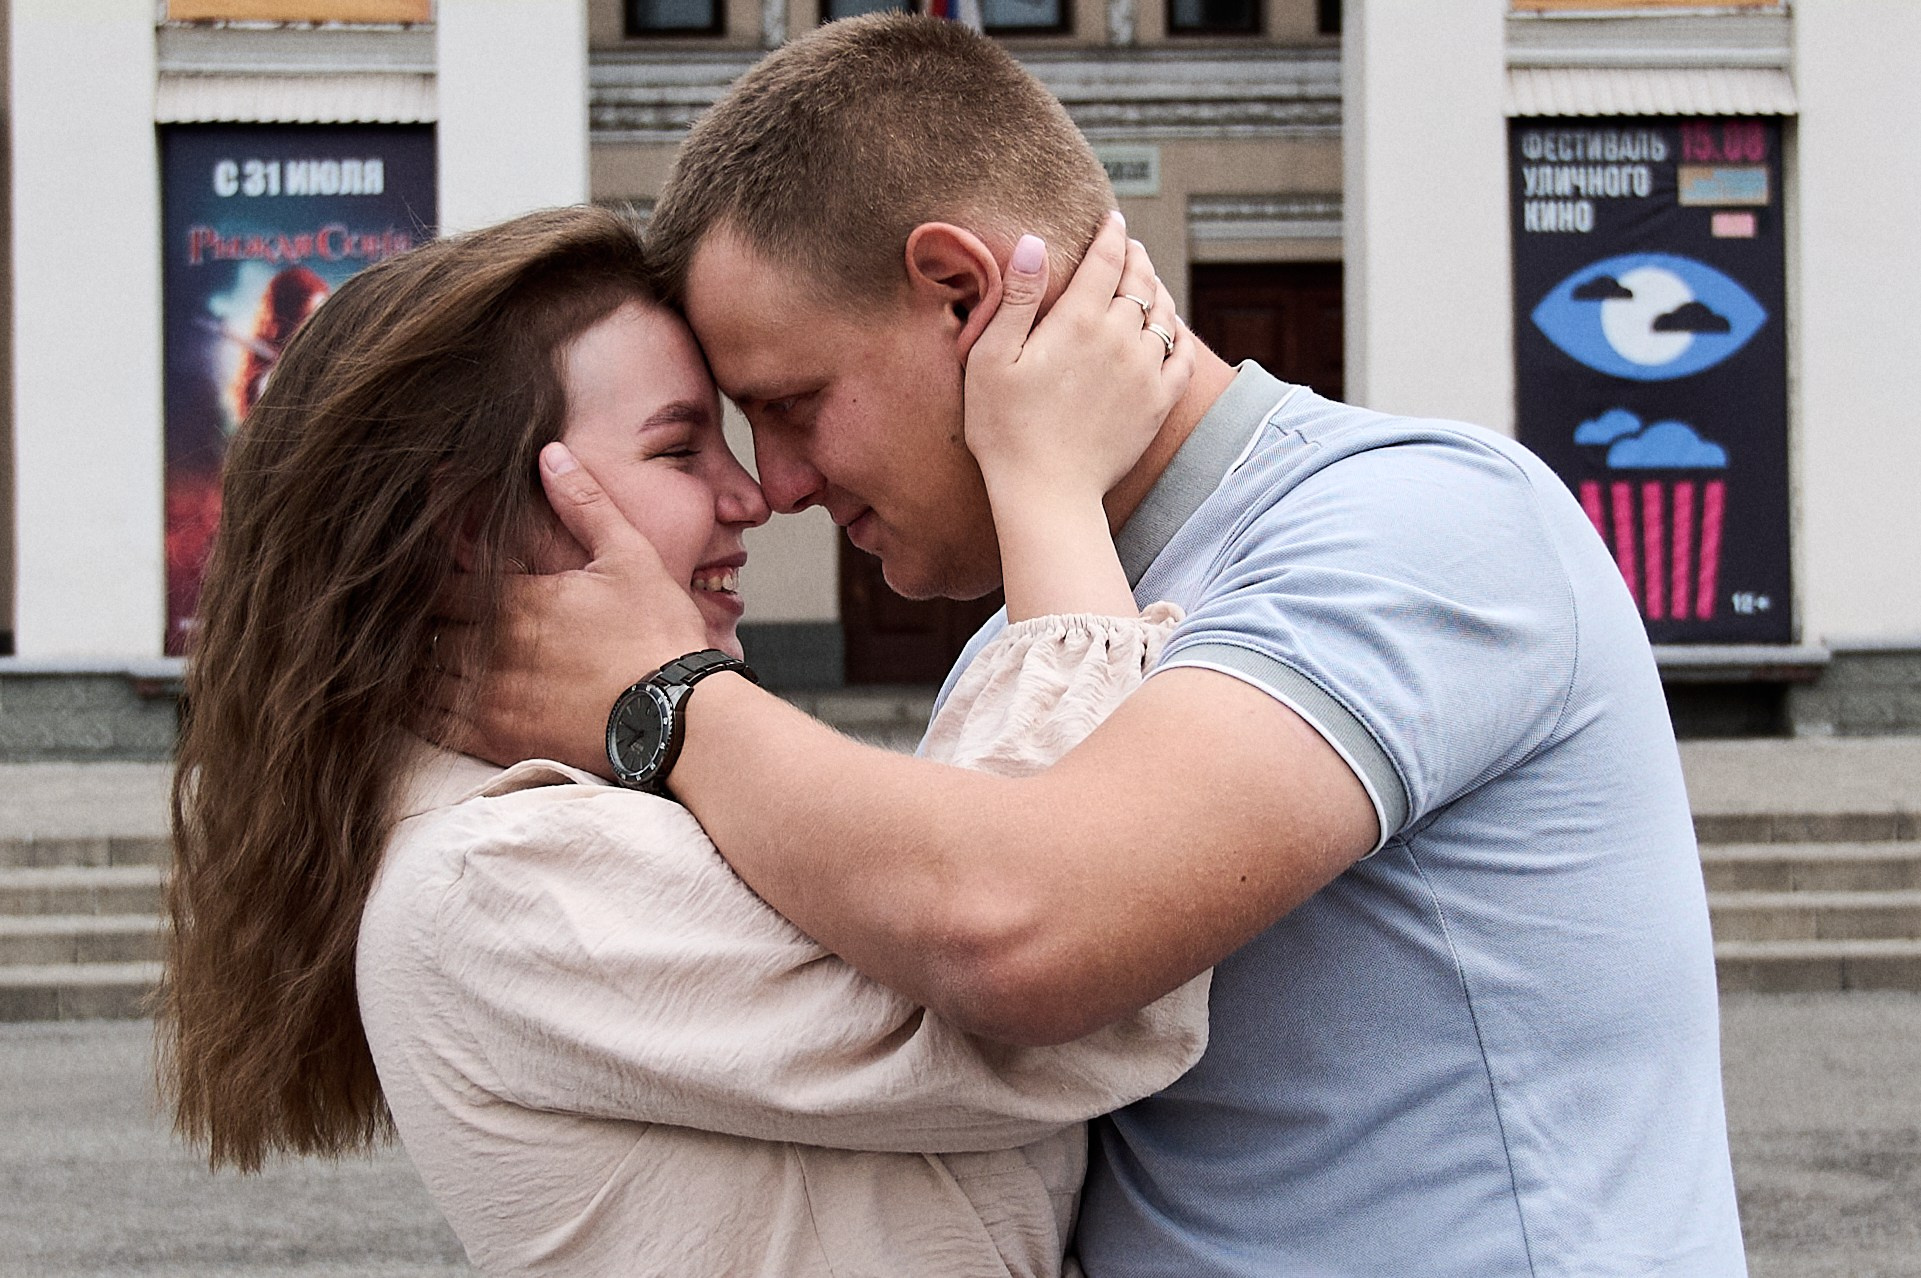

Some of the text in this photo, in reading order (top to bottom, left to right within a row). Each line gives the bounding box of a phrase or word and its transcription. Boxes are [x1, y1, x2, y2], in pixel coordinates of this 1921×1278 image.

[1522, 129, 1667, 161] ФЕСТИВАЛЬ
[213, 159, 384, 197] С 31 ИЮЛЯ
[1522, 164, 1652, 198] УЛИЧНОГО
[1523, 200, 1595, 233] КИНО
